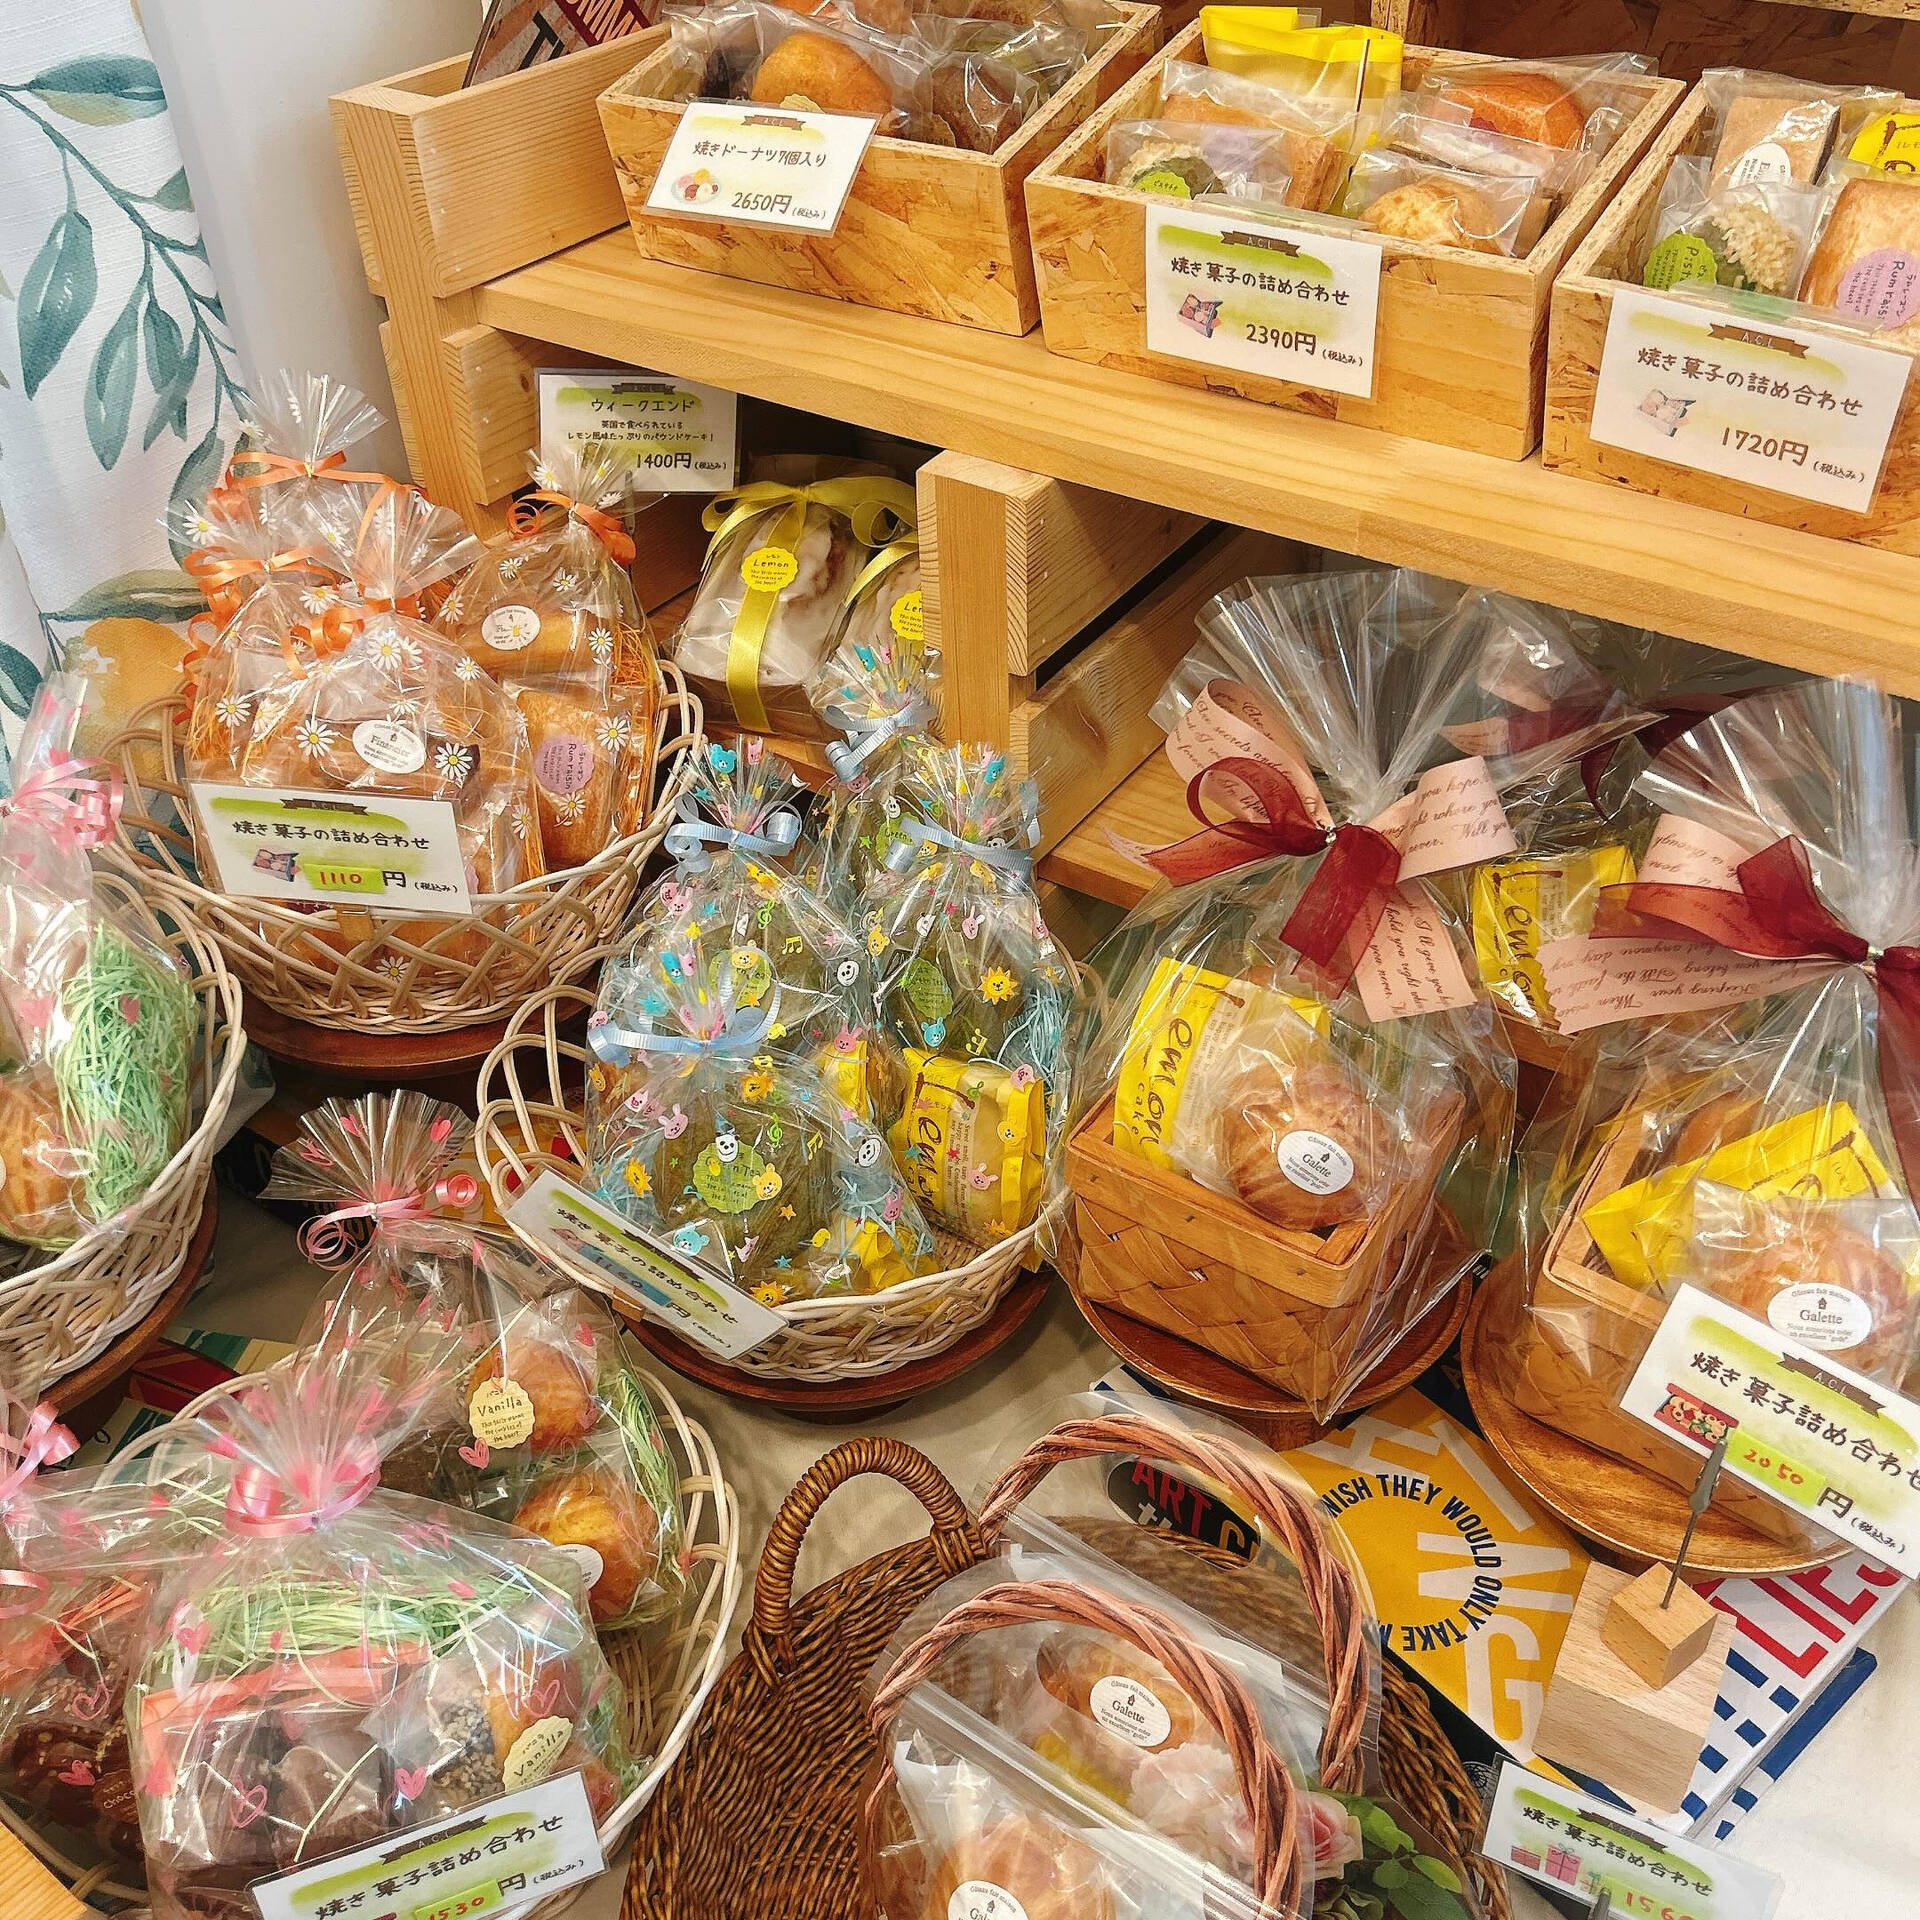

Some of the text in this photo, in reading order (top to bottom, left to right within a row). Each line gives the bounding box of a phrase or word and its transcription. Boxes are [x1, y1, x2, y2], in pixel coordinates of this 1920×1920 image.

[693, 141, 826, 167] 焼きドーナツ7個入り
[731, 192, 792, 213] 2650円
[1171, 257, 1350, 306] 焼き菓子の詰め合わせ
[1246, 324, 1316, 355] 2390円
[1637, 347, 1863, 418] 焼き菓子の詰め合わせ
[591, 399, 695, 412] ウィークエンド
[601, 420, 683, 429] 英国で食べられている
[636, 452, 692, 469] 1400円
[1722, 426, 1809, 467] 1720円
[754, 559, 789, 568] Lemon
[232, 821, 430, 850] 焼き菓子の詰め合わせ
[320, 871, 363, 885] 1110
[1131, 1082, 1145, 1135] cake
[1302, 1154, 1331, 1178] Galette
[556, 1208, 738, 1325] 焼き菓子の詰め合わせ
[1800, 1309, 1843, 1324] Galette
[477, 1397, 522, 1416] Vanilla
[1132, 1460, 1213, 1538] ART
[1375, 1474, 1443, 1506] THEY
[1440, 1495, 1502, 1569] WOULD
[1458, 1574, 1503, 1632] ONLY
[1402, 1617, 1468, 1651] TAKE
[1112, 1700, 1145, 1724] Galette
[514, 1731, 564, 1776] Vanilla
[315, 1815, 564, 1919] 焼き菓子詰め合わせ
[1523, 1806, 1713, 1898] 焼き菓子詰め合わせ
